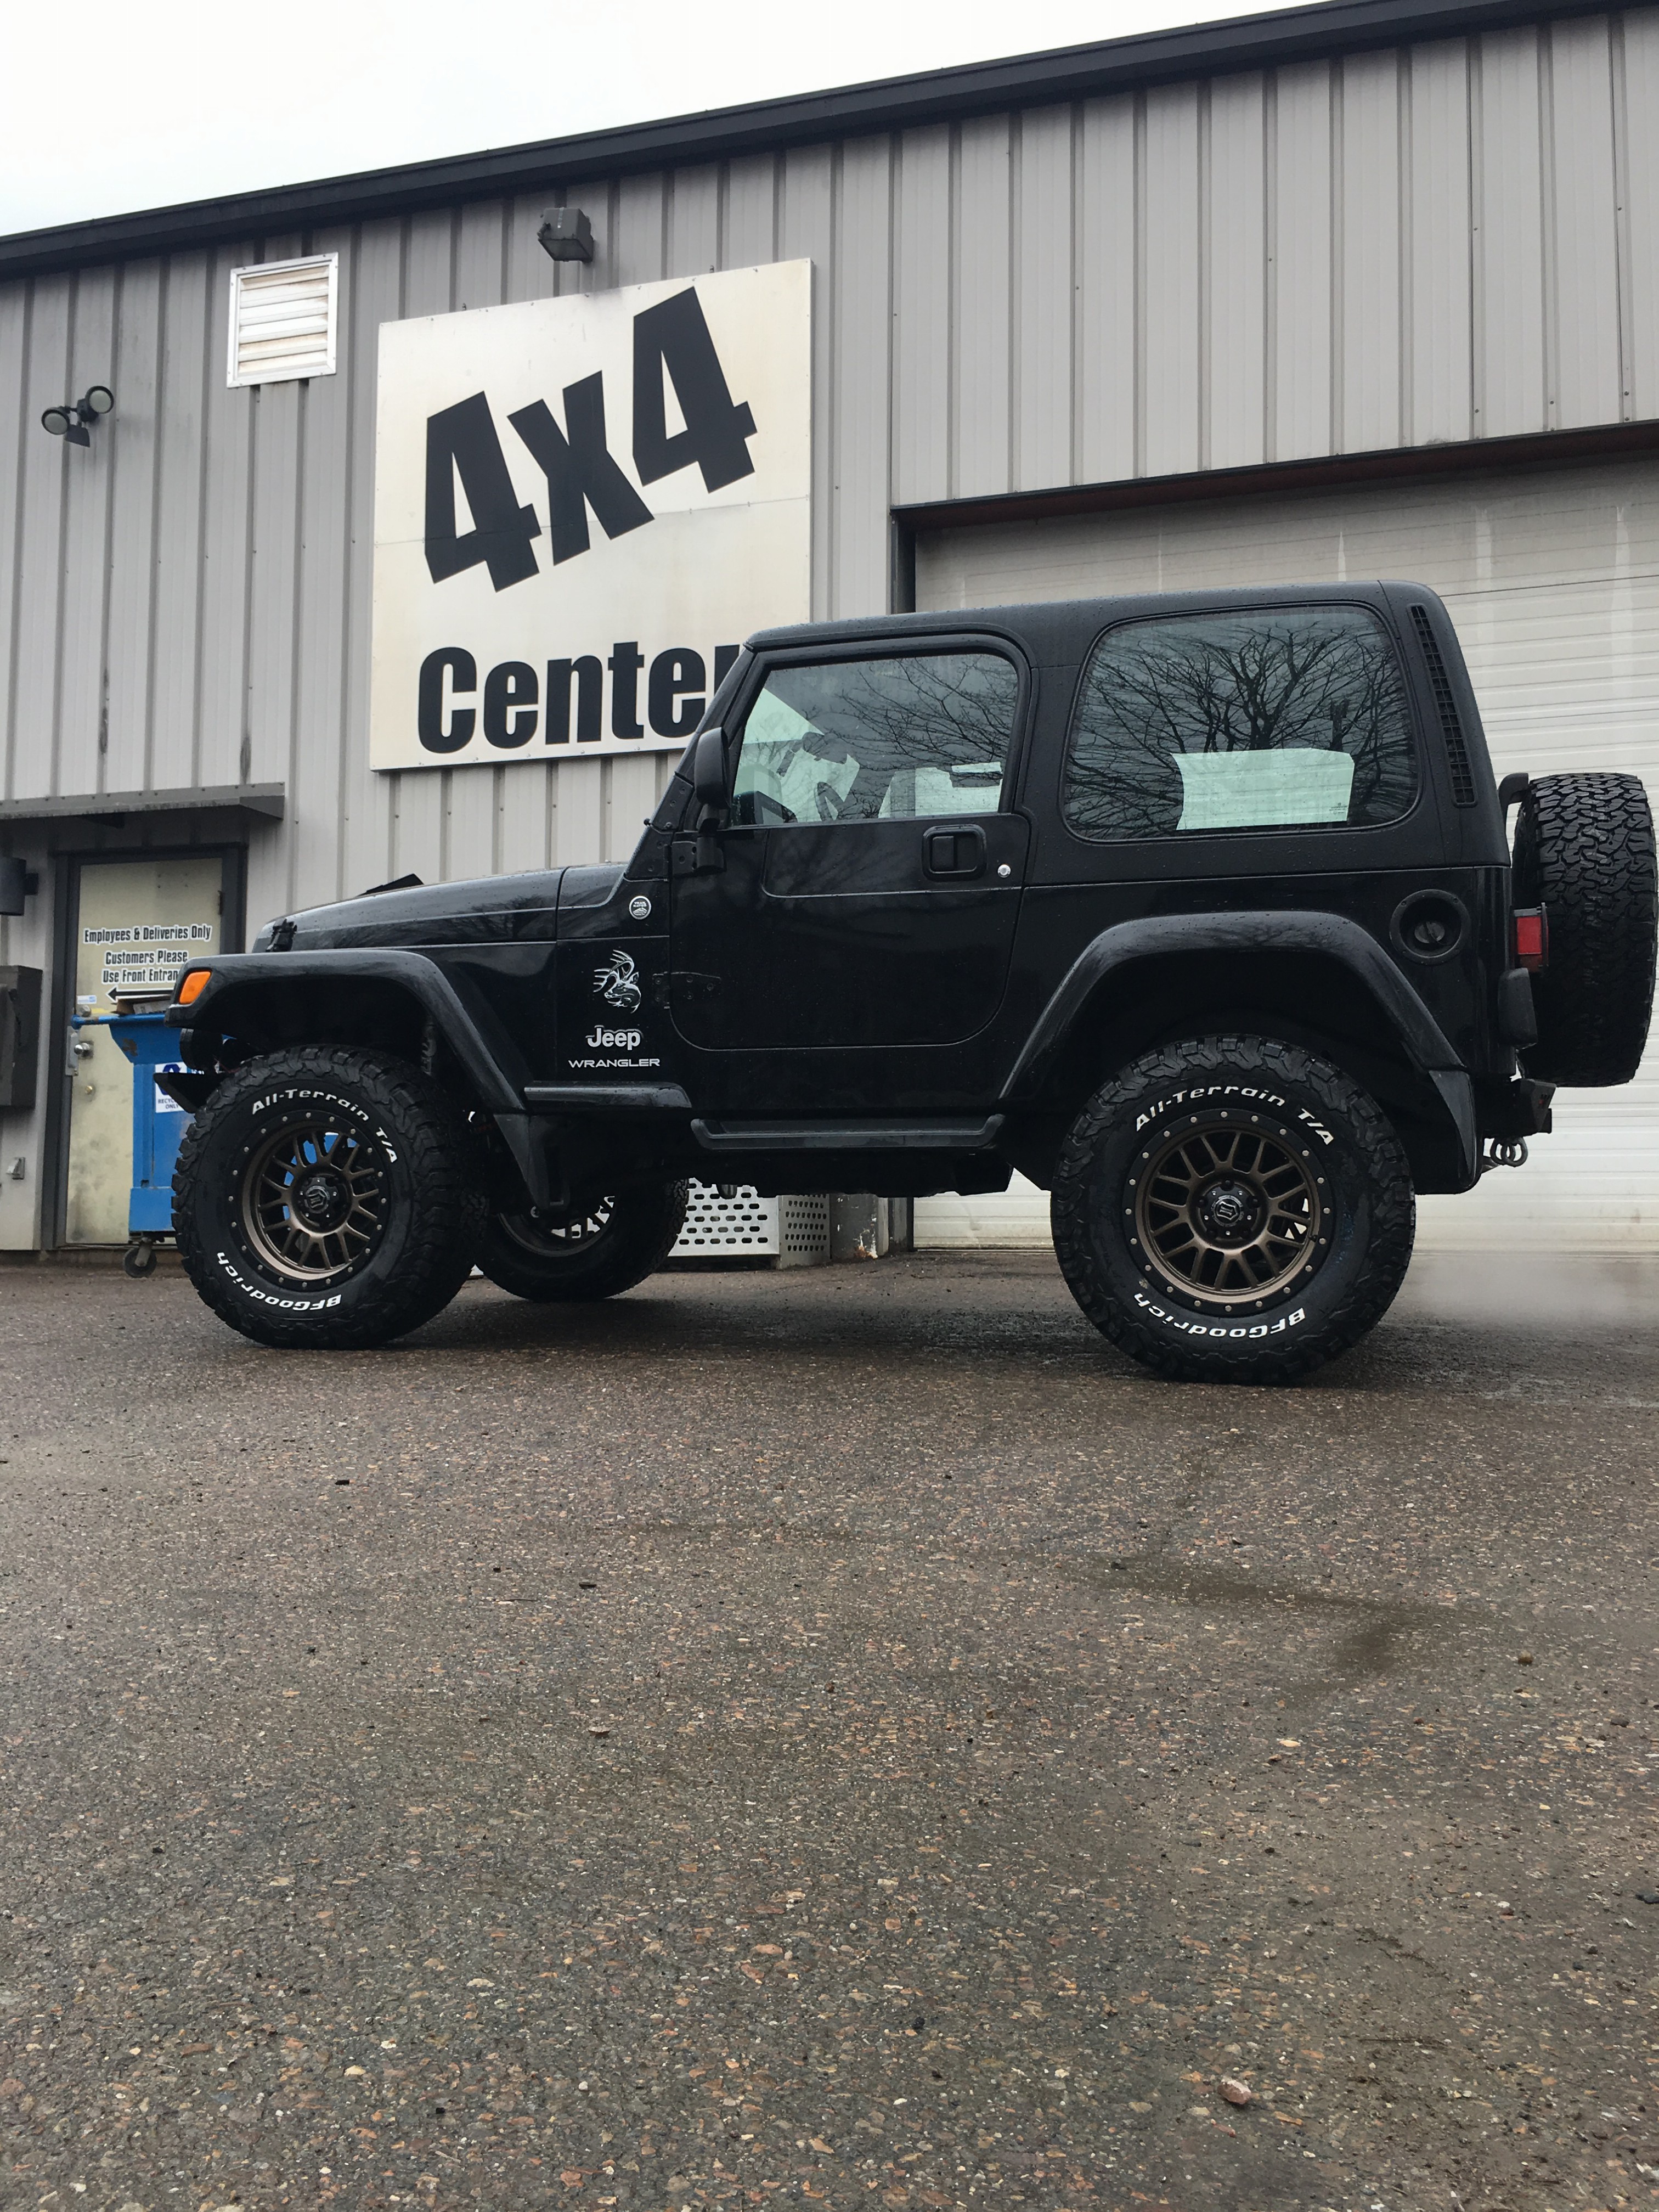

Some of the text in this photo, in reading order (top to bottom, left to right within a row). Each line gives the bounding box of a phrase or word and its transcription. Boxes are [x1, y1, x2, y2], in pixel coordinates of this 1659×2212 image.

[424, 286, 758, 593] 4x4
[84, 925, 211, 944] Employees & Deliveries Only
[105, 950, 188, 965] Customers Please
[103, 968, 178, 983] Use Front Entran
[587, 1028, 641, 1050] Jeep
[568, 1058, 660, 1068] WRANGLER
[252, 1089, 398, 1163] All-Terrain T/A
[1136, 1085, 1334, 1145] All-Terrain T/A
[217, 1252, 342, 1311] BFGoodrich
[1133, 1292, 1306, 1338] BFGoodrich
